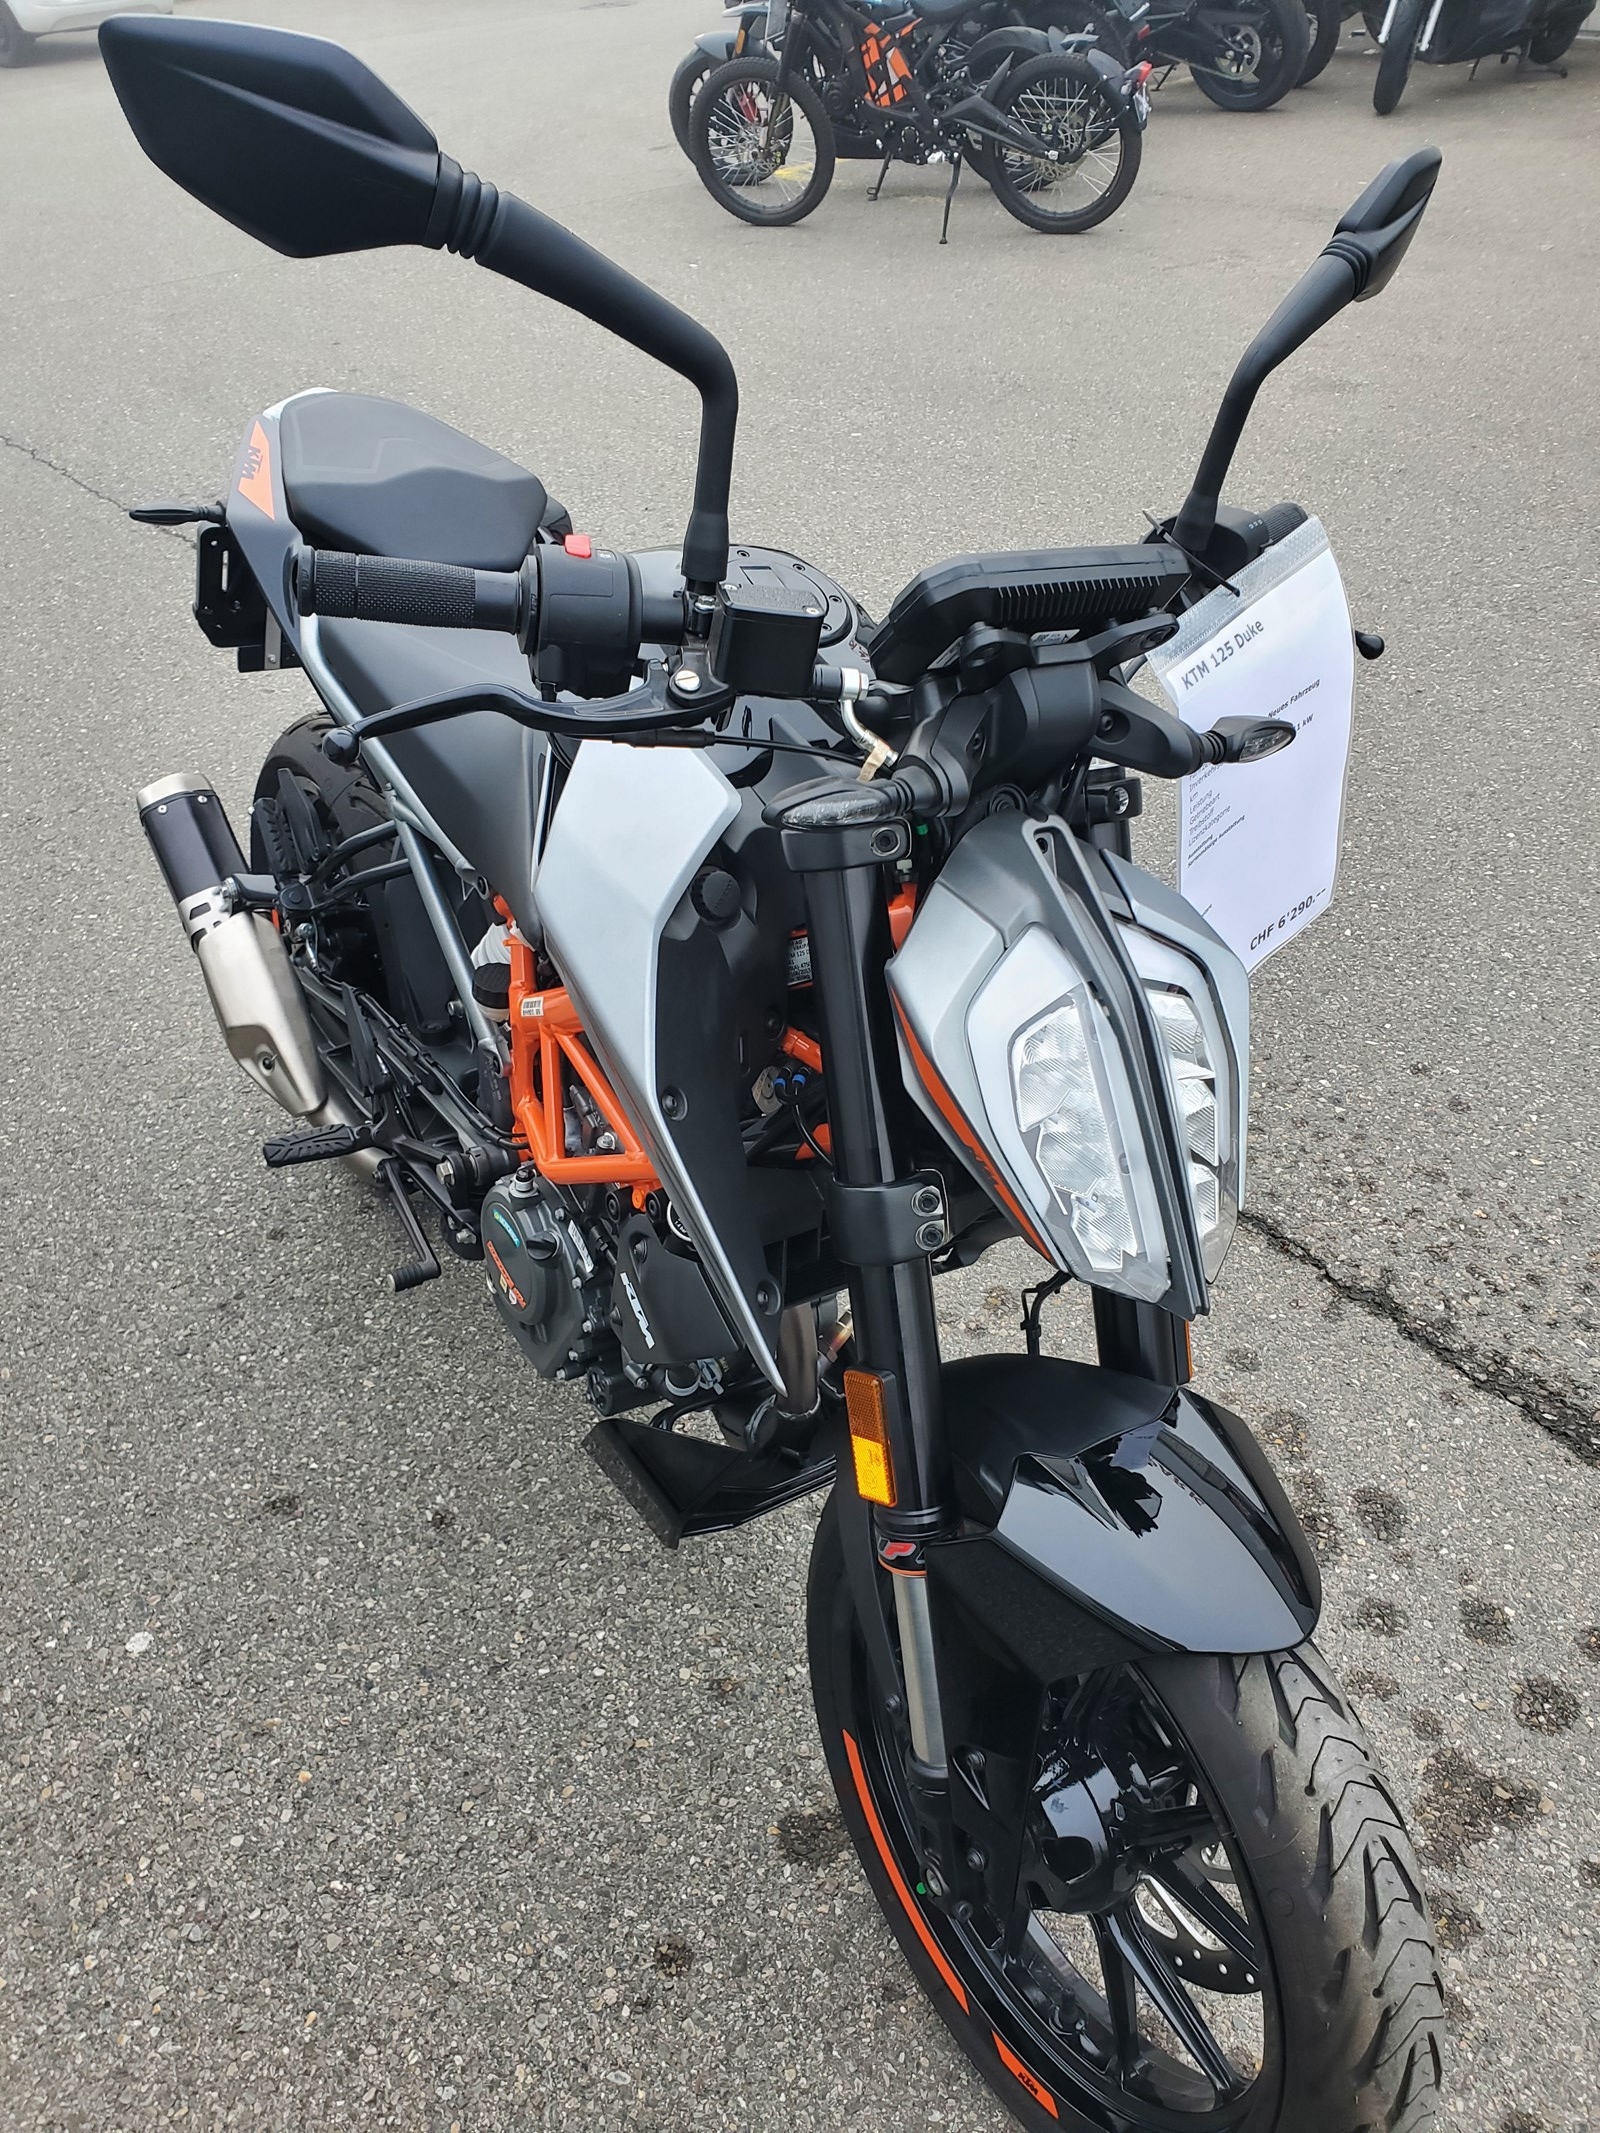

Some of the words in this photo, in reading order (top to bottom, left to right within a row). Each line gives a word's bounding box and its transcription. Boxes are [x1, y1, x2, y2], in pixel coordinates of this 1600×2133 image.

[241, 446, 264, 480] KTM
[1181, 660, 1210, 690] KTM
[1210, 641, 1234, 668] 125
[1234, 621, 1264, 649] Duke
[1268, 701, 1289, 719] Neues
[1290, 679, 1320, 704] Fahrzeug
[1302, 713, 1314, 727] kW
[1190, 790, 1212, 815] Leistung
[1190, 793, 1220, 825] Getriebeart
[1189, 807, 1215, 836] Treibstoff
[1189, 805, 1231, 847] Lizenzkategorie
[1250, 923, 1275, 951] CHF
[1278, 888, 1327, 929] 6'290.--
[620, 1272, 655, 1349] KTM
[1018, 2072, 1039, 2095] KTM
